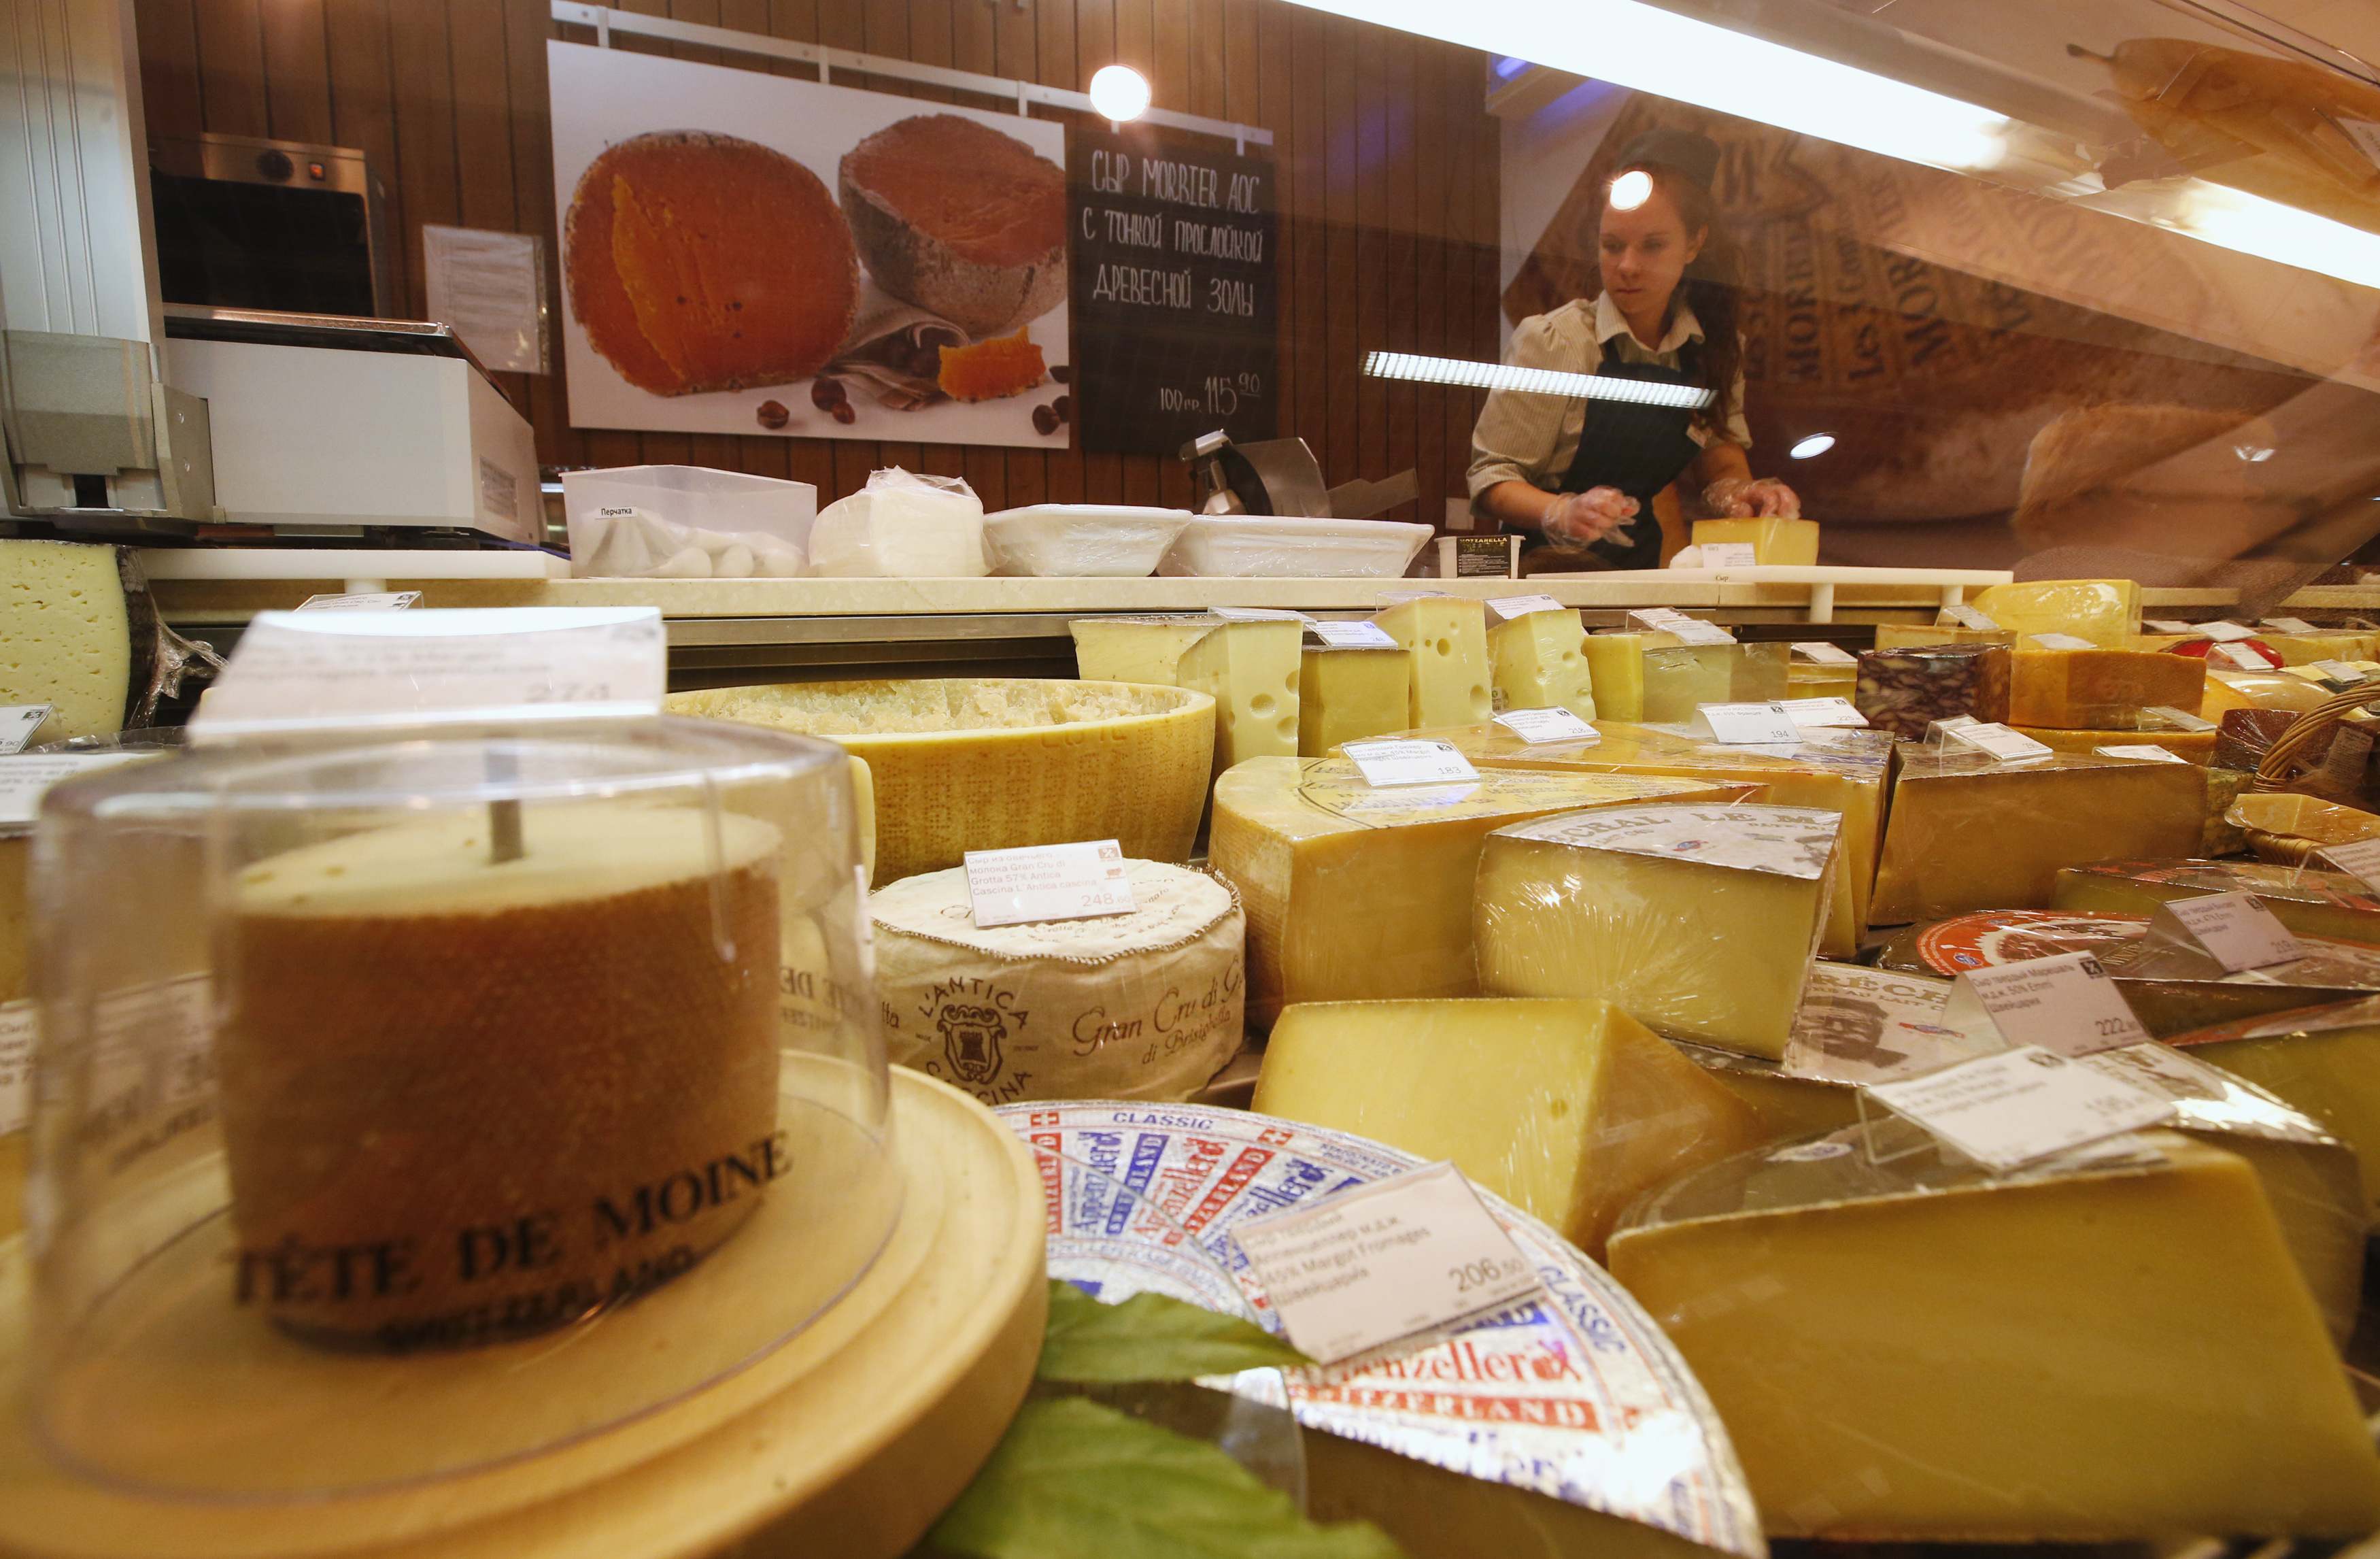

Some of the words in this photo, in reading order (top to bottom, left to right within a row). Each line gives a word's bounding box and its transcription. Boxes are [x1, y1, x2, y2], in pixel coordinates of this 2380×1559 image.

[1091, 150, 1129, 194] СЫР
[1142, 158, 1219, 208] MORBIER
[1083, 207, 1095, 240] С
[1105, 209, 1161, 249] ТОНКОЙ
[1175, 220, 1263, 263] ПРОСЛОЙКОЙ
[1092, 264, 1191, 309] ДРЕВЕСНОЙ
[1207, 278, 1253, 317] ЗОЛЫ
[601, 507, 632, 517] Перчатка
[1770, 730, 1789, 739] 194
[1437, 767, 1462, 775] 183
[970, 865, 1008, 875] молока
[1010, 863, 1035, 871] Gran
[1057, 859, 1066, 868] di
[971, 875, 1003, 886] Grotta
[1030, 871, 1061, 880] Antica
[973, 885, 1013, 896] Cascina
[1072, 1006, 1143, 1056] Gran
[1154, 987, 1197, 1033] Cru
[1202, 976, 1219, 1009] di
[1142, 1043, 1158, 1065] di
[1112, 1112, 1214, 1130] CLASSIC
[458, 1213, 560, 1283] DE
[594, 1132, 794, 1243] MOINE
[1538, 1265, 1627, 1353] CLASSIC
